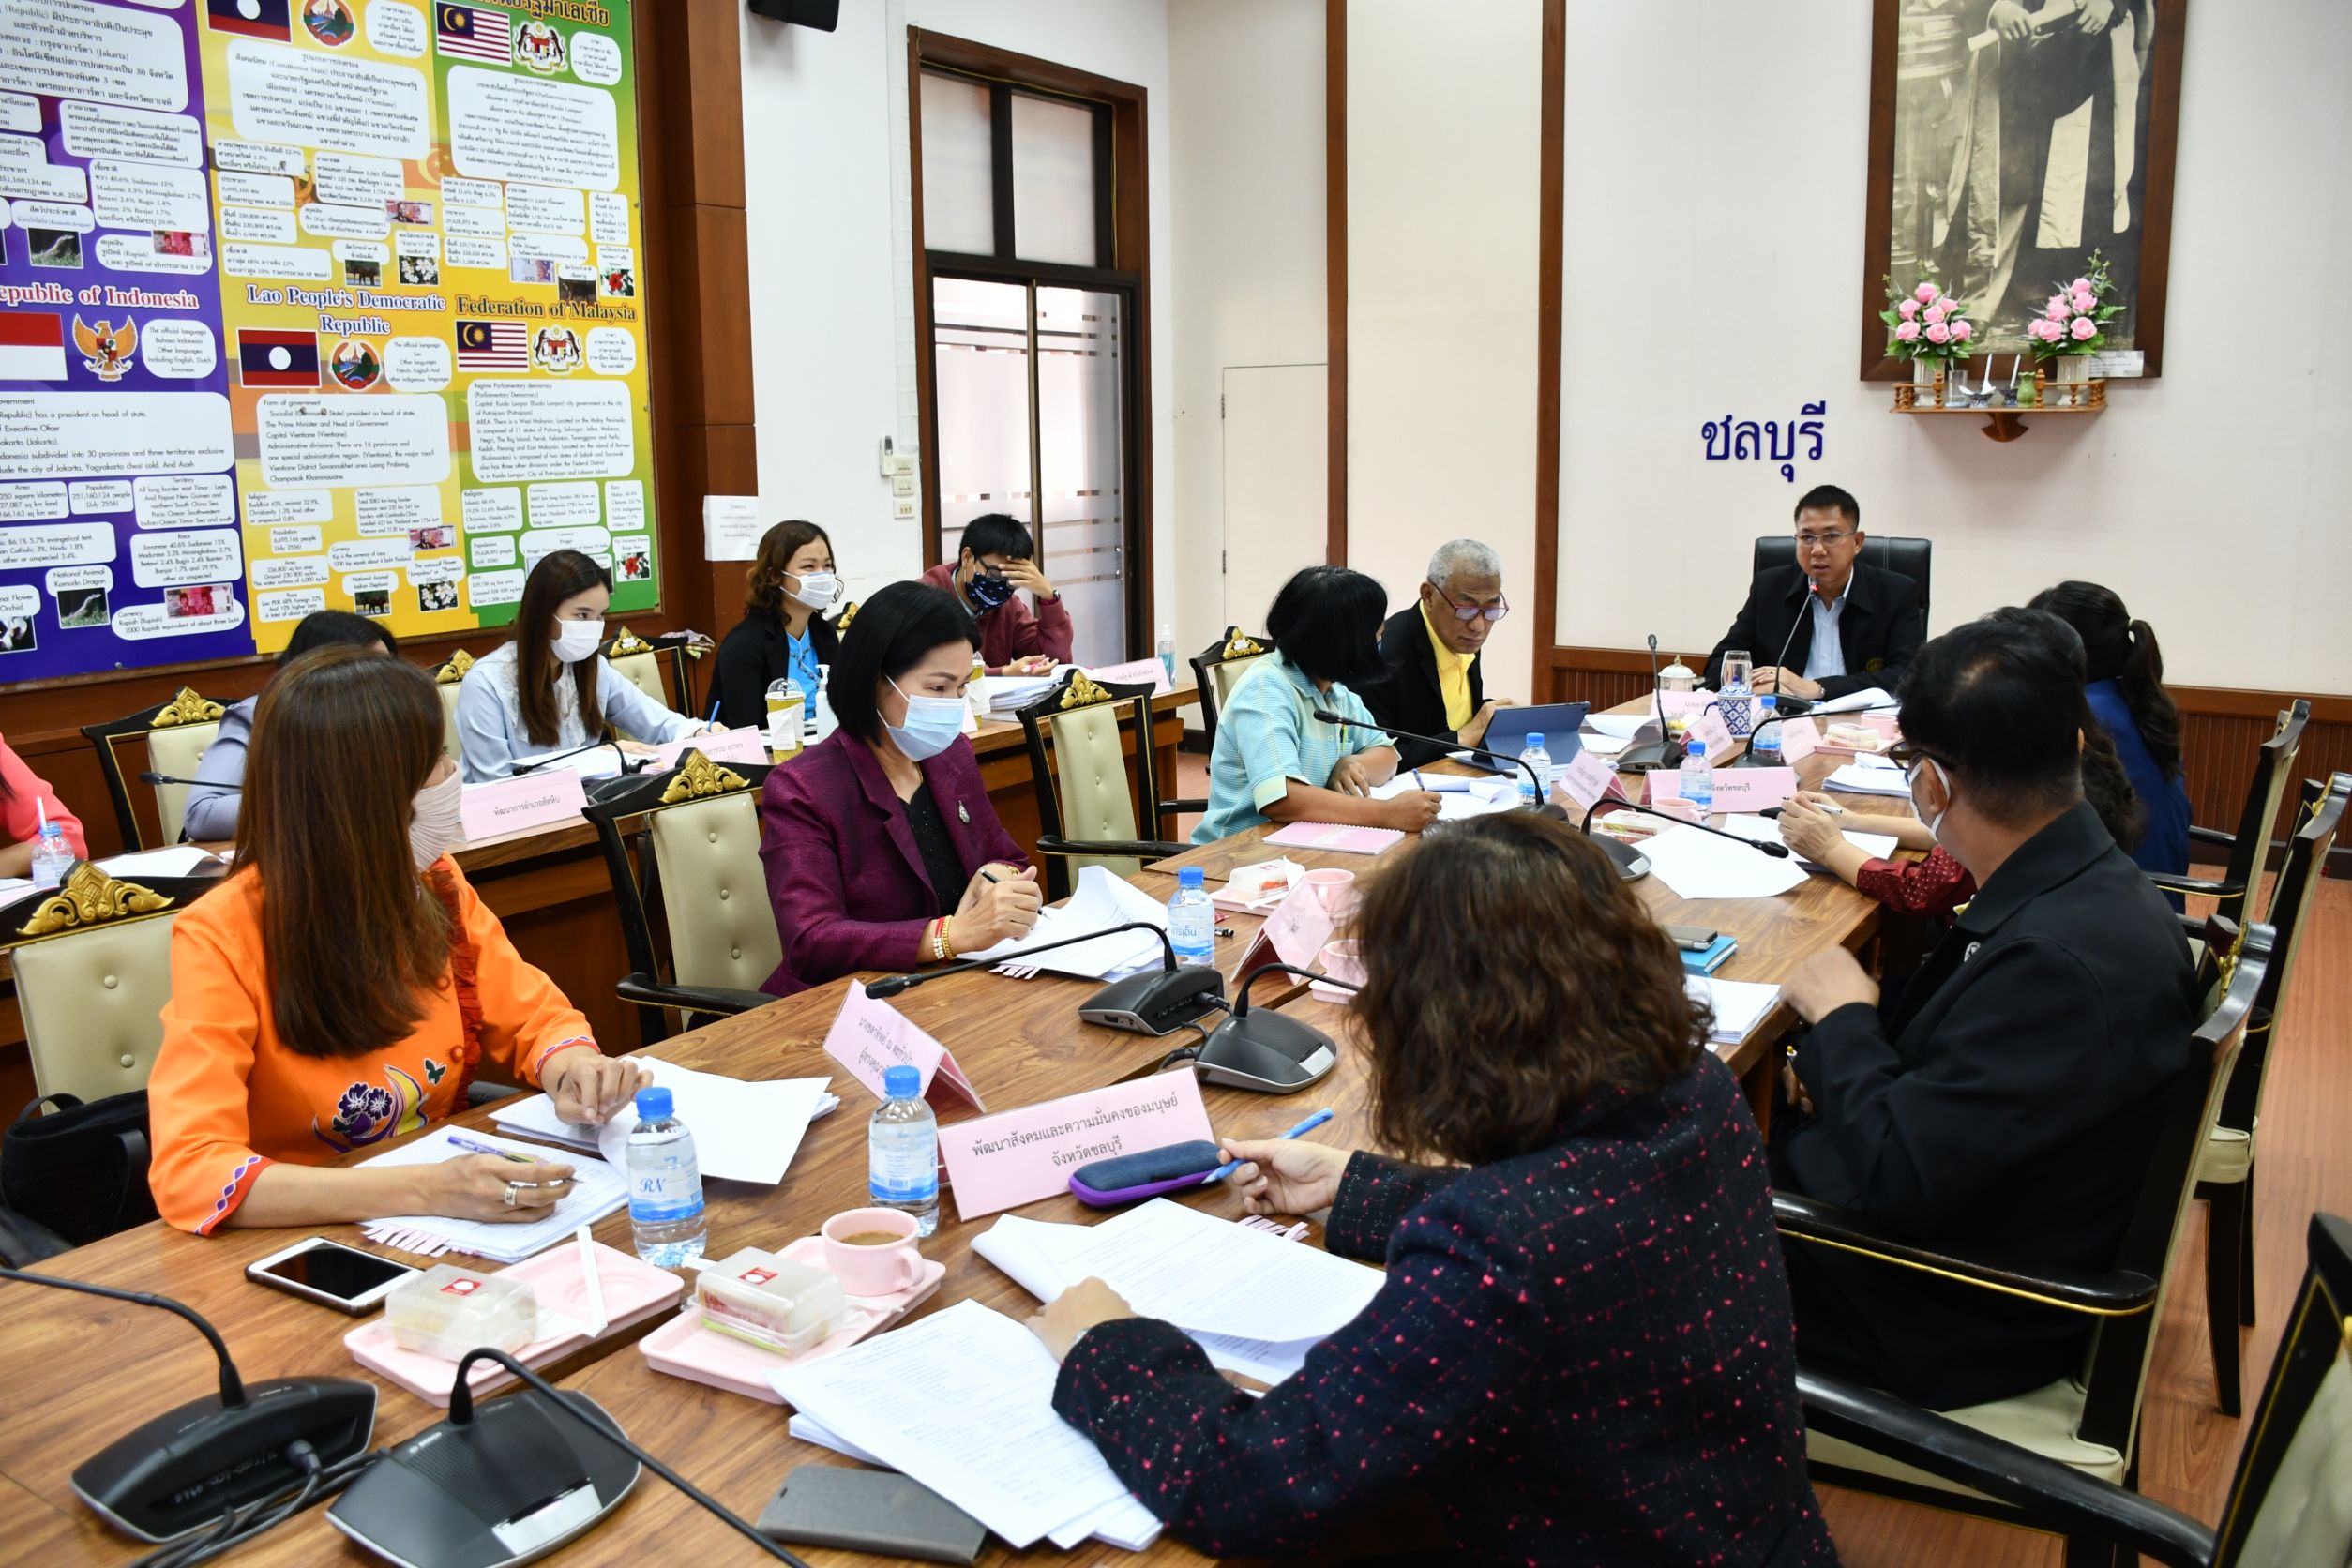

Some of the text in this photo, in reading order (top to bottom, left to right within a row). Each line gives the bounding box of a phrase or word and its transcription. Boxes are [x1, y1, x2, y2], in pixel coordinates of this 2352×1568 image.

[80, 285, 100, 304] of
[107, 287, 198, 309] Indonesia
[248, 285, 445, 309] Lao People's Democratic
[457, 296, 636, 323] Federation of Malaysia
[321, 316, 390, 336] Republic
[35, 410, 48, 418] has
[58, 410, 90, 420] president
[1701, 400, 1826, 483] ชลบุรี
[84, 567, 104, 576] Animal
[972, 1091, 1179, 1157] พัฒนาสังคมและความมั่นคงของมนุษย์
[1051, 1134, 1124, 1168] จังหวัดชลบุรี
